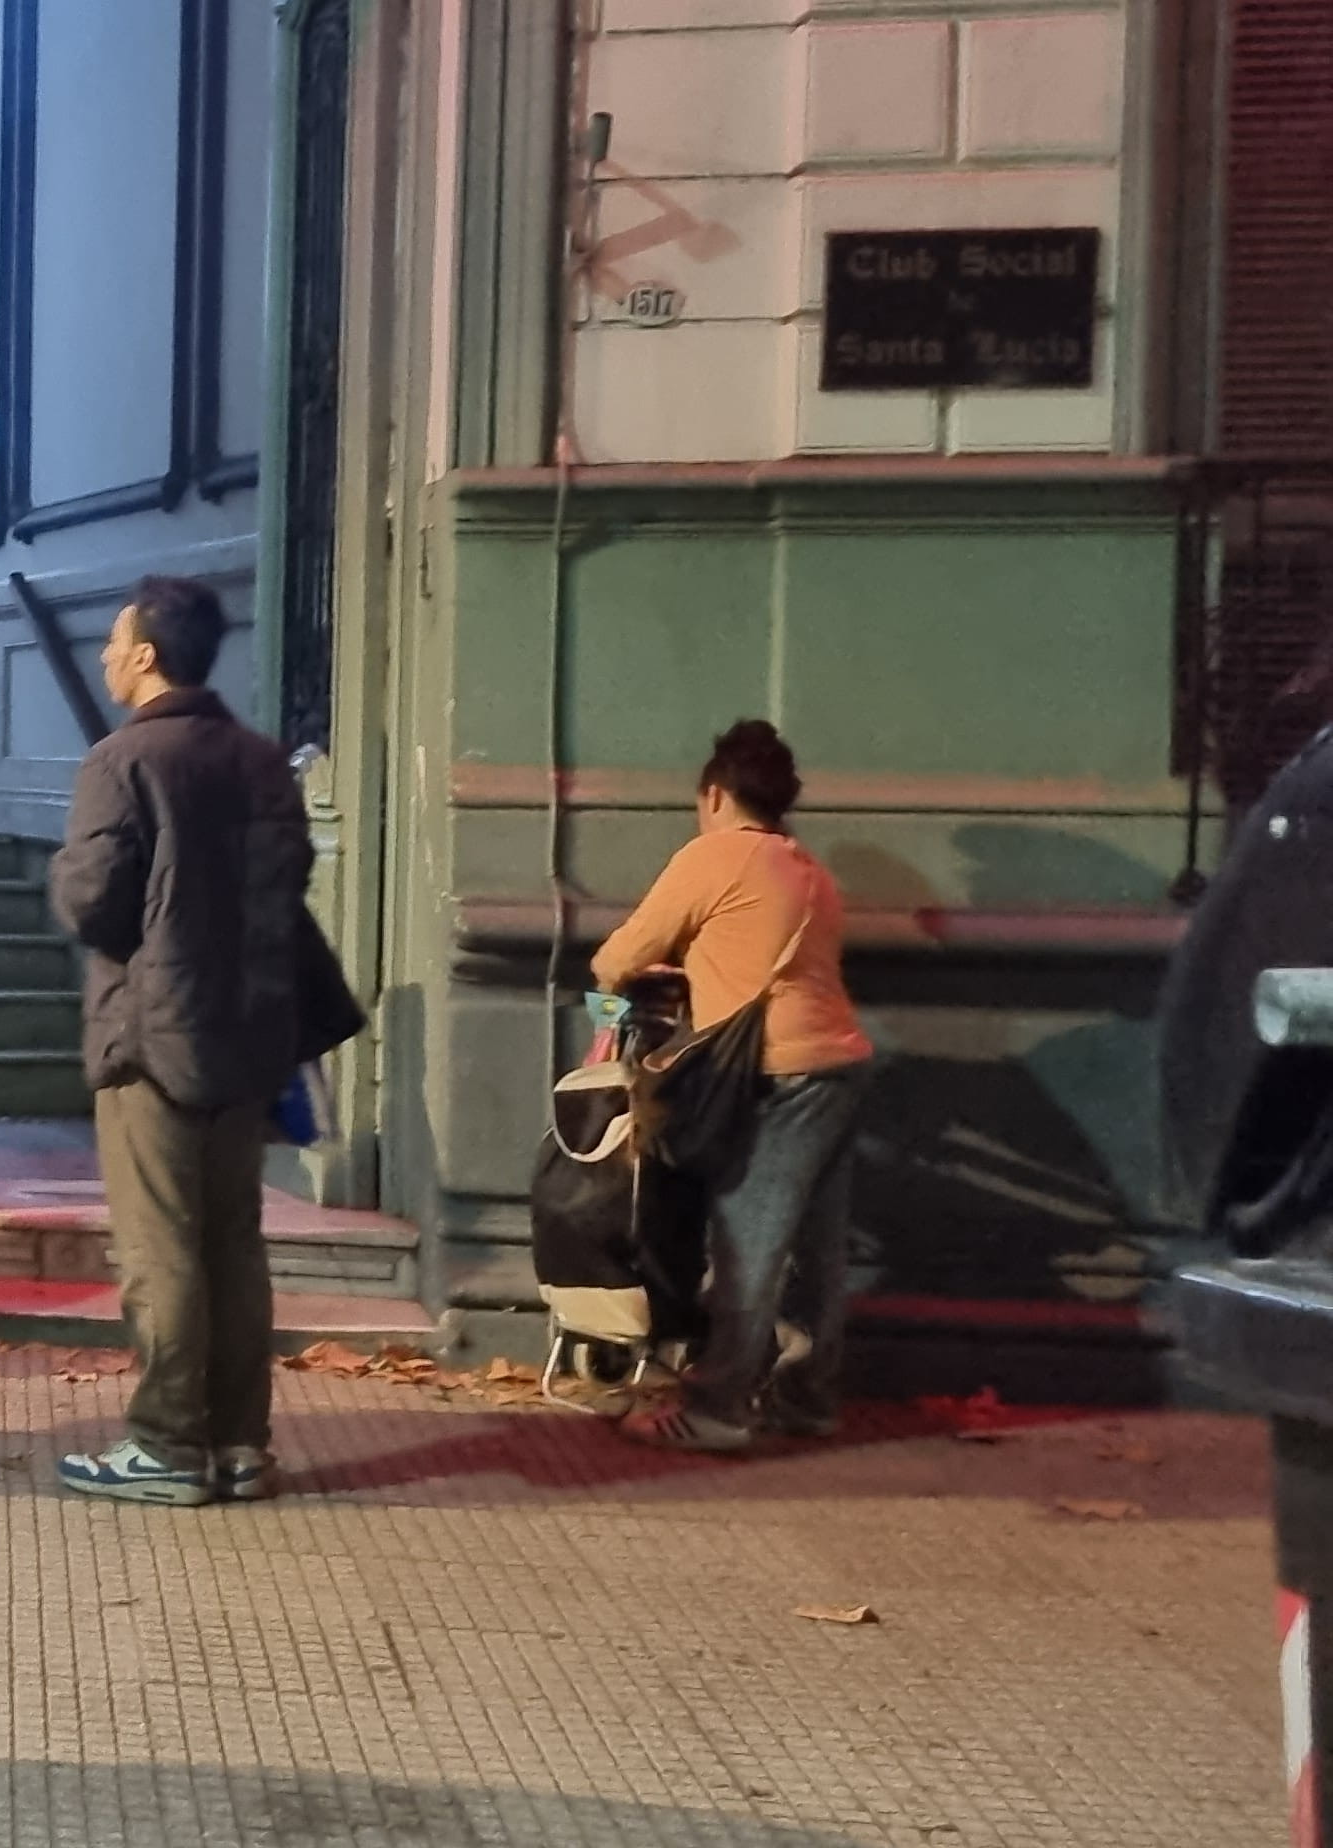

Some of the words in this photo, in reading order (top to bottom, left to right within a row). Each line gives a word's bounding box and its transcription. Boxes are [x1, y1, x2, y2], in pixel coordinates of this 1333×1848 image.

[846, 245, 939, 280] Club
[959, 241, 1077, 278] Social
[629, 288, 675, 316] 1517
[835, 331, 945, 366] Santa
